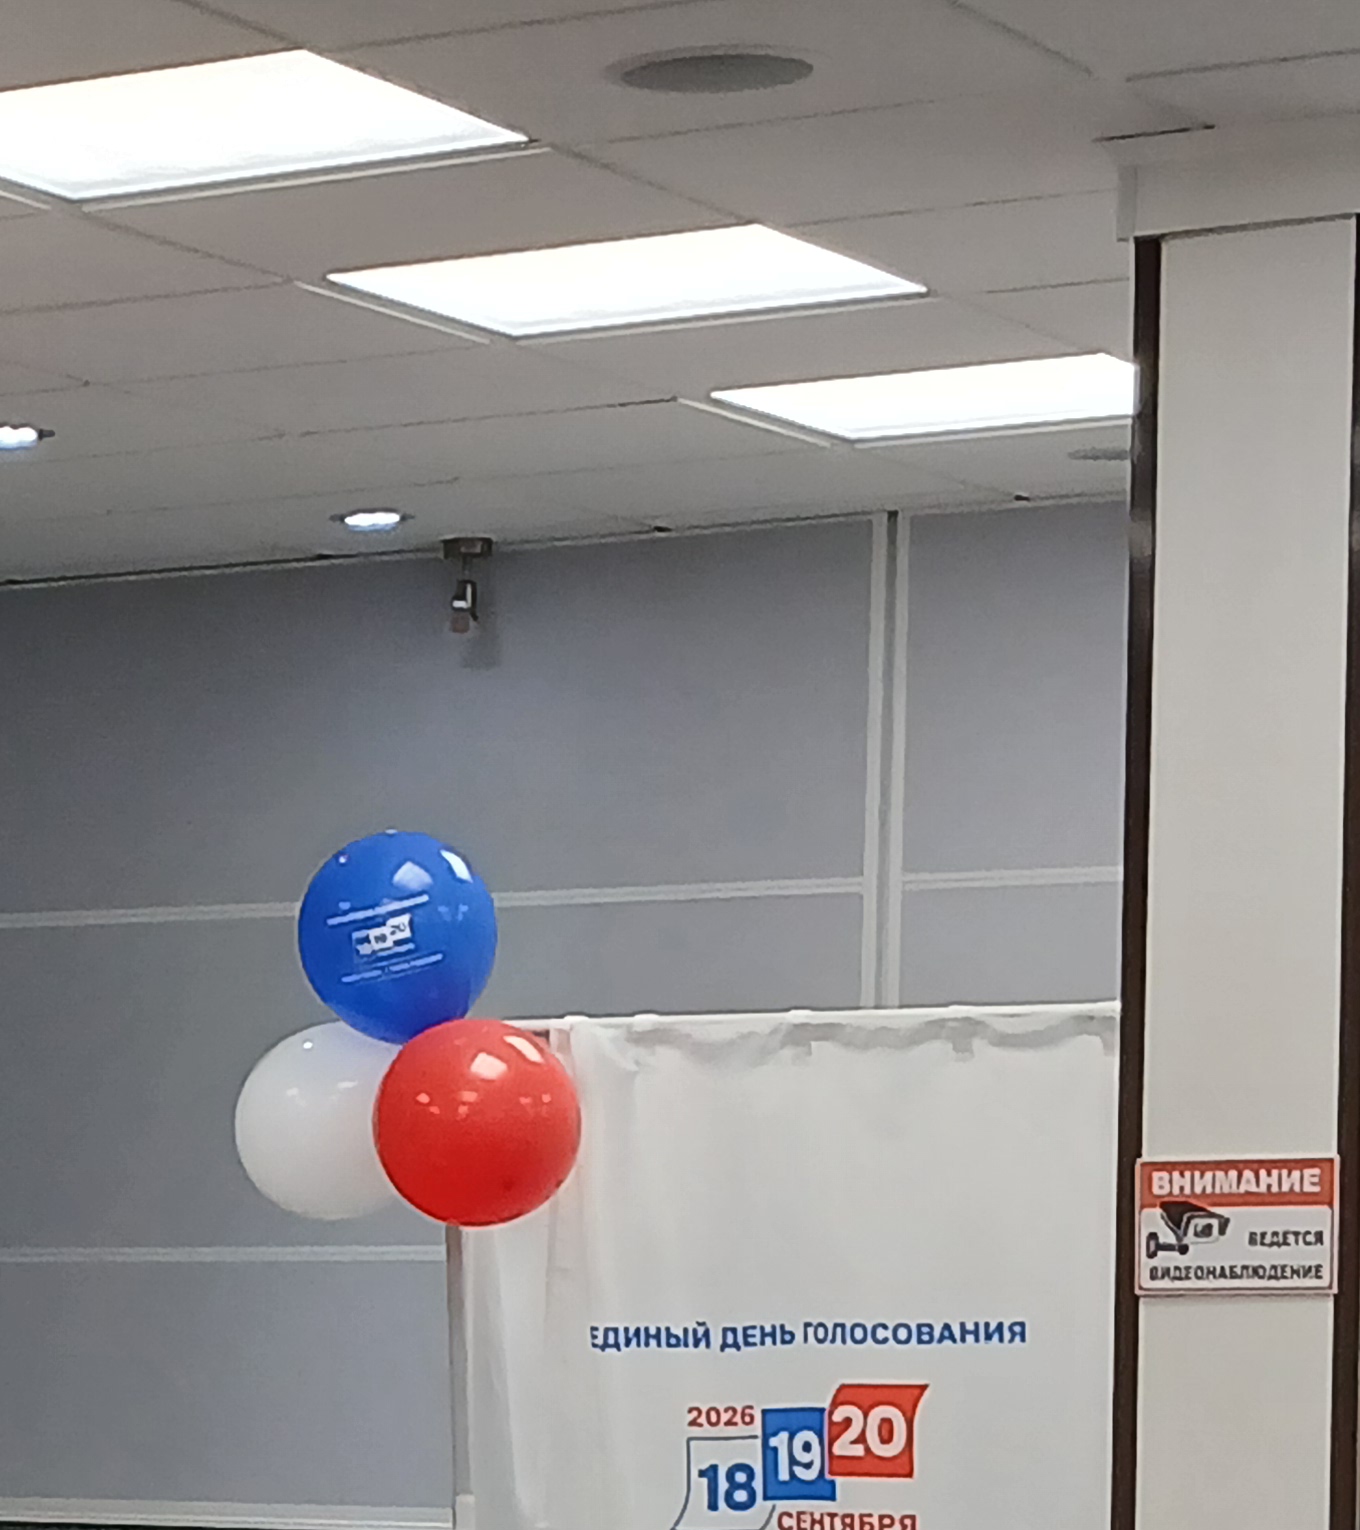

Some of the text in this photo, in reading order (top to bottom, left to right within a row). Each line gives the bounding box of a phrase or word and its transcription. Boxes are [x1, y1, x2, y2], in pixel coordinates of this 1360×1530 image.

[1151, 1168, 1321, 1195] ВНИМАНИЕ
[1248, 1230, 1324, 1247] ВЕДЕТСЯ
[1149, 1264, 1323, 1281] ВИДЕОНАБЛЮДЕНИЕ
[590, 1321, 1027, 1352] ЕДИНЫЙ ДЕНЬ ГОЛОСОВАНИЯ
[686, 1406, 755, 1428] 2026
[697, 1405, 907, 1512] 18 19 20
